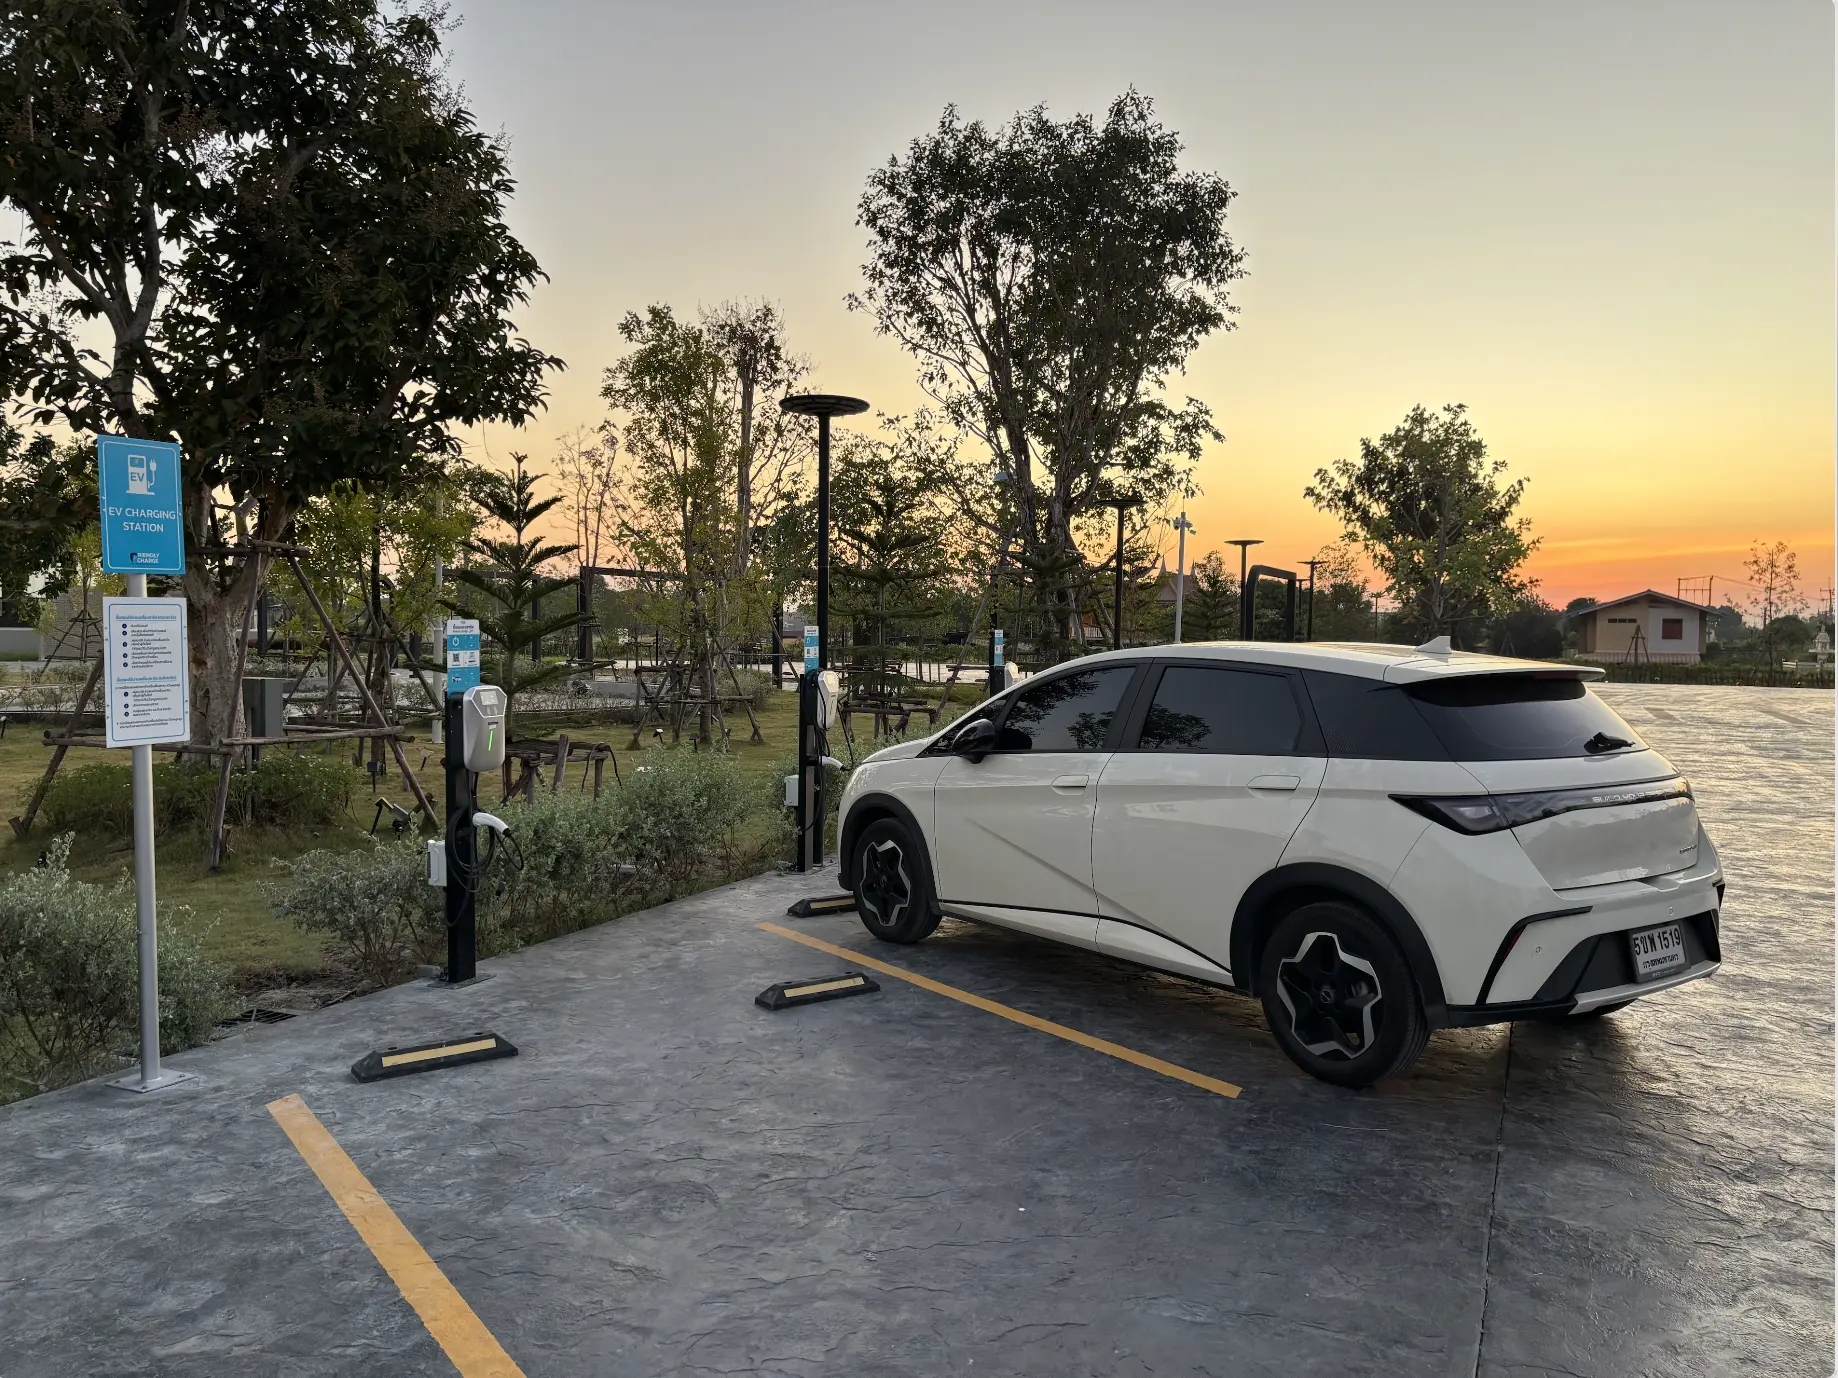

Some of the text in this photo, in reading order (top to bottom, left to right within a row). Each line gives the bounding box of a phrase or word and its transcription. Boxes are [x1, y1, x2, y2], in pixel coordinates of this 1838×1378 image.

[131, 473, 145, 482] EV
[108, 507, 176, 519] EV CHARGING
[123, 522, 164, 532] STATION
[1657, 928, 1681, 950] 1519
